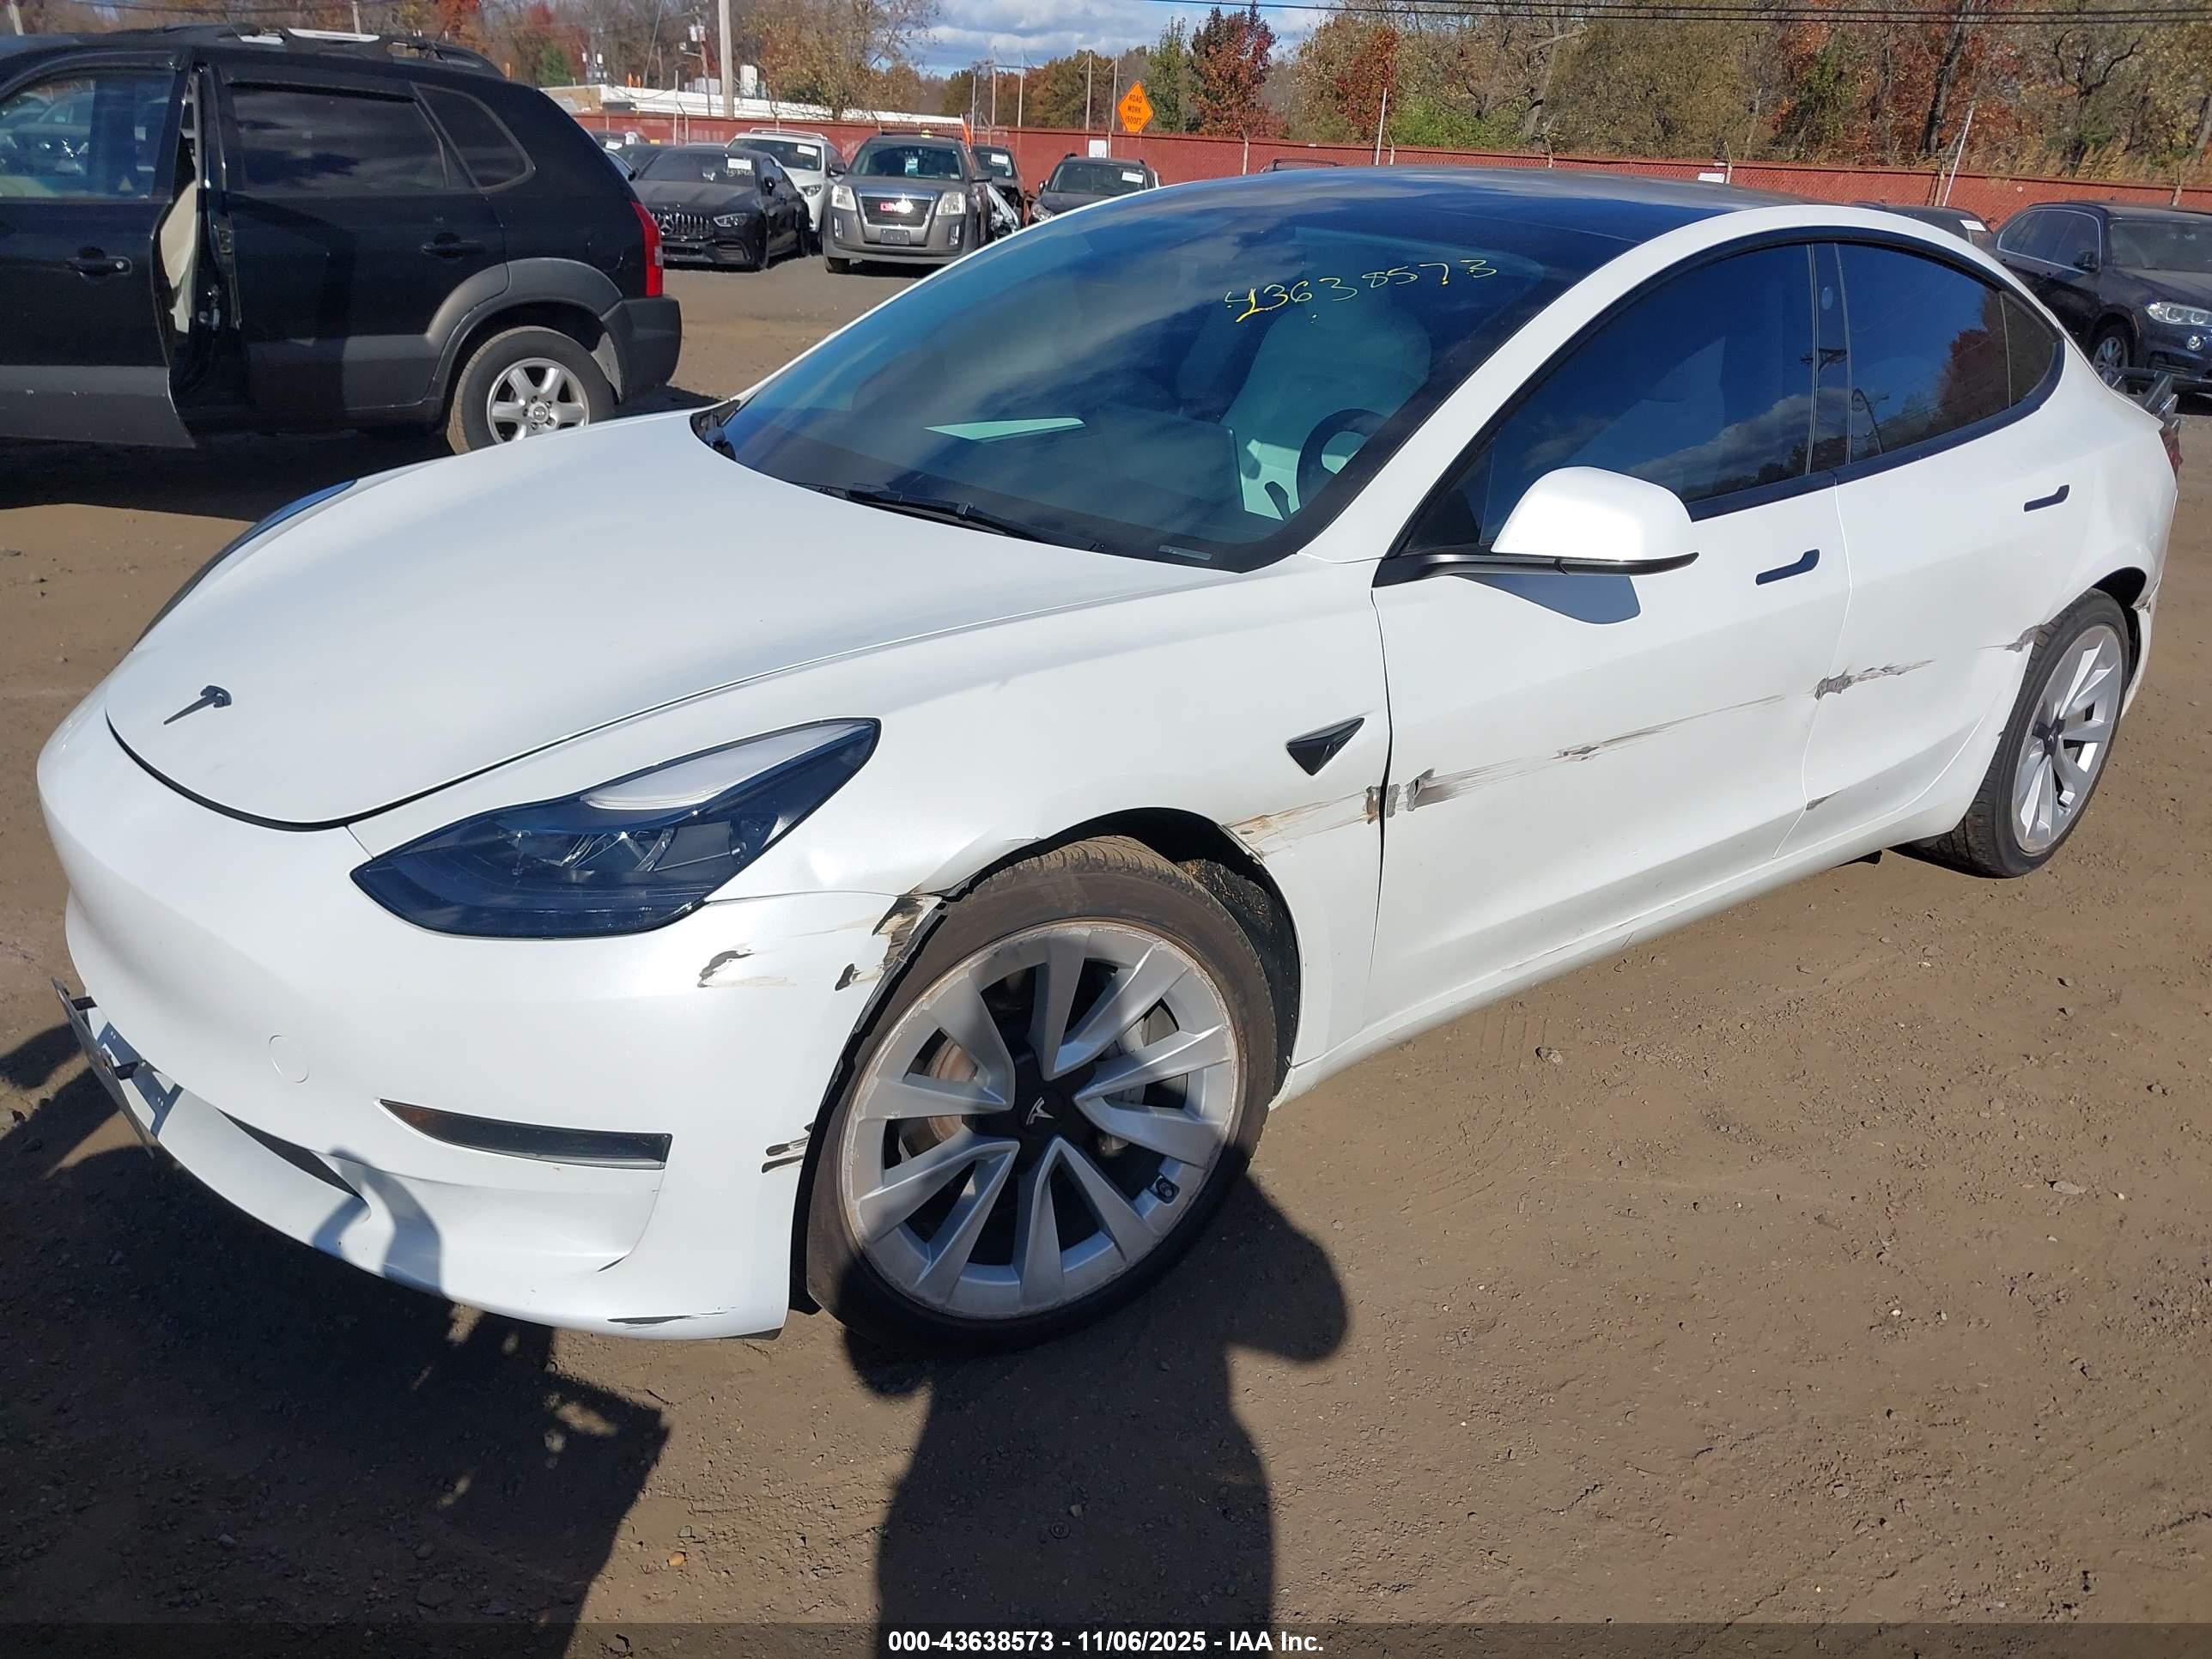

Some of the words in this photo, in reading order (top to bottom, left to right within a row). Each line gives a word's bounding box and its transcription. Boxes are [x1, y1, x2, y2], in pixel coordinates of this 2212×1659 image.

[1129, 94, 1143, 104] ROAD
[1127, 105, 1141, 113] WORK
[880, 202, 910, 213] GM
